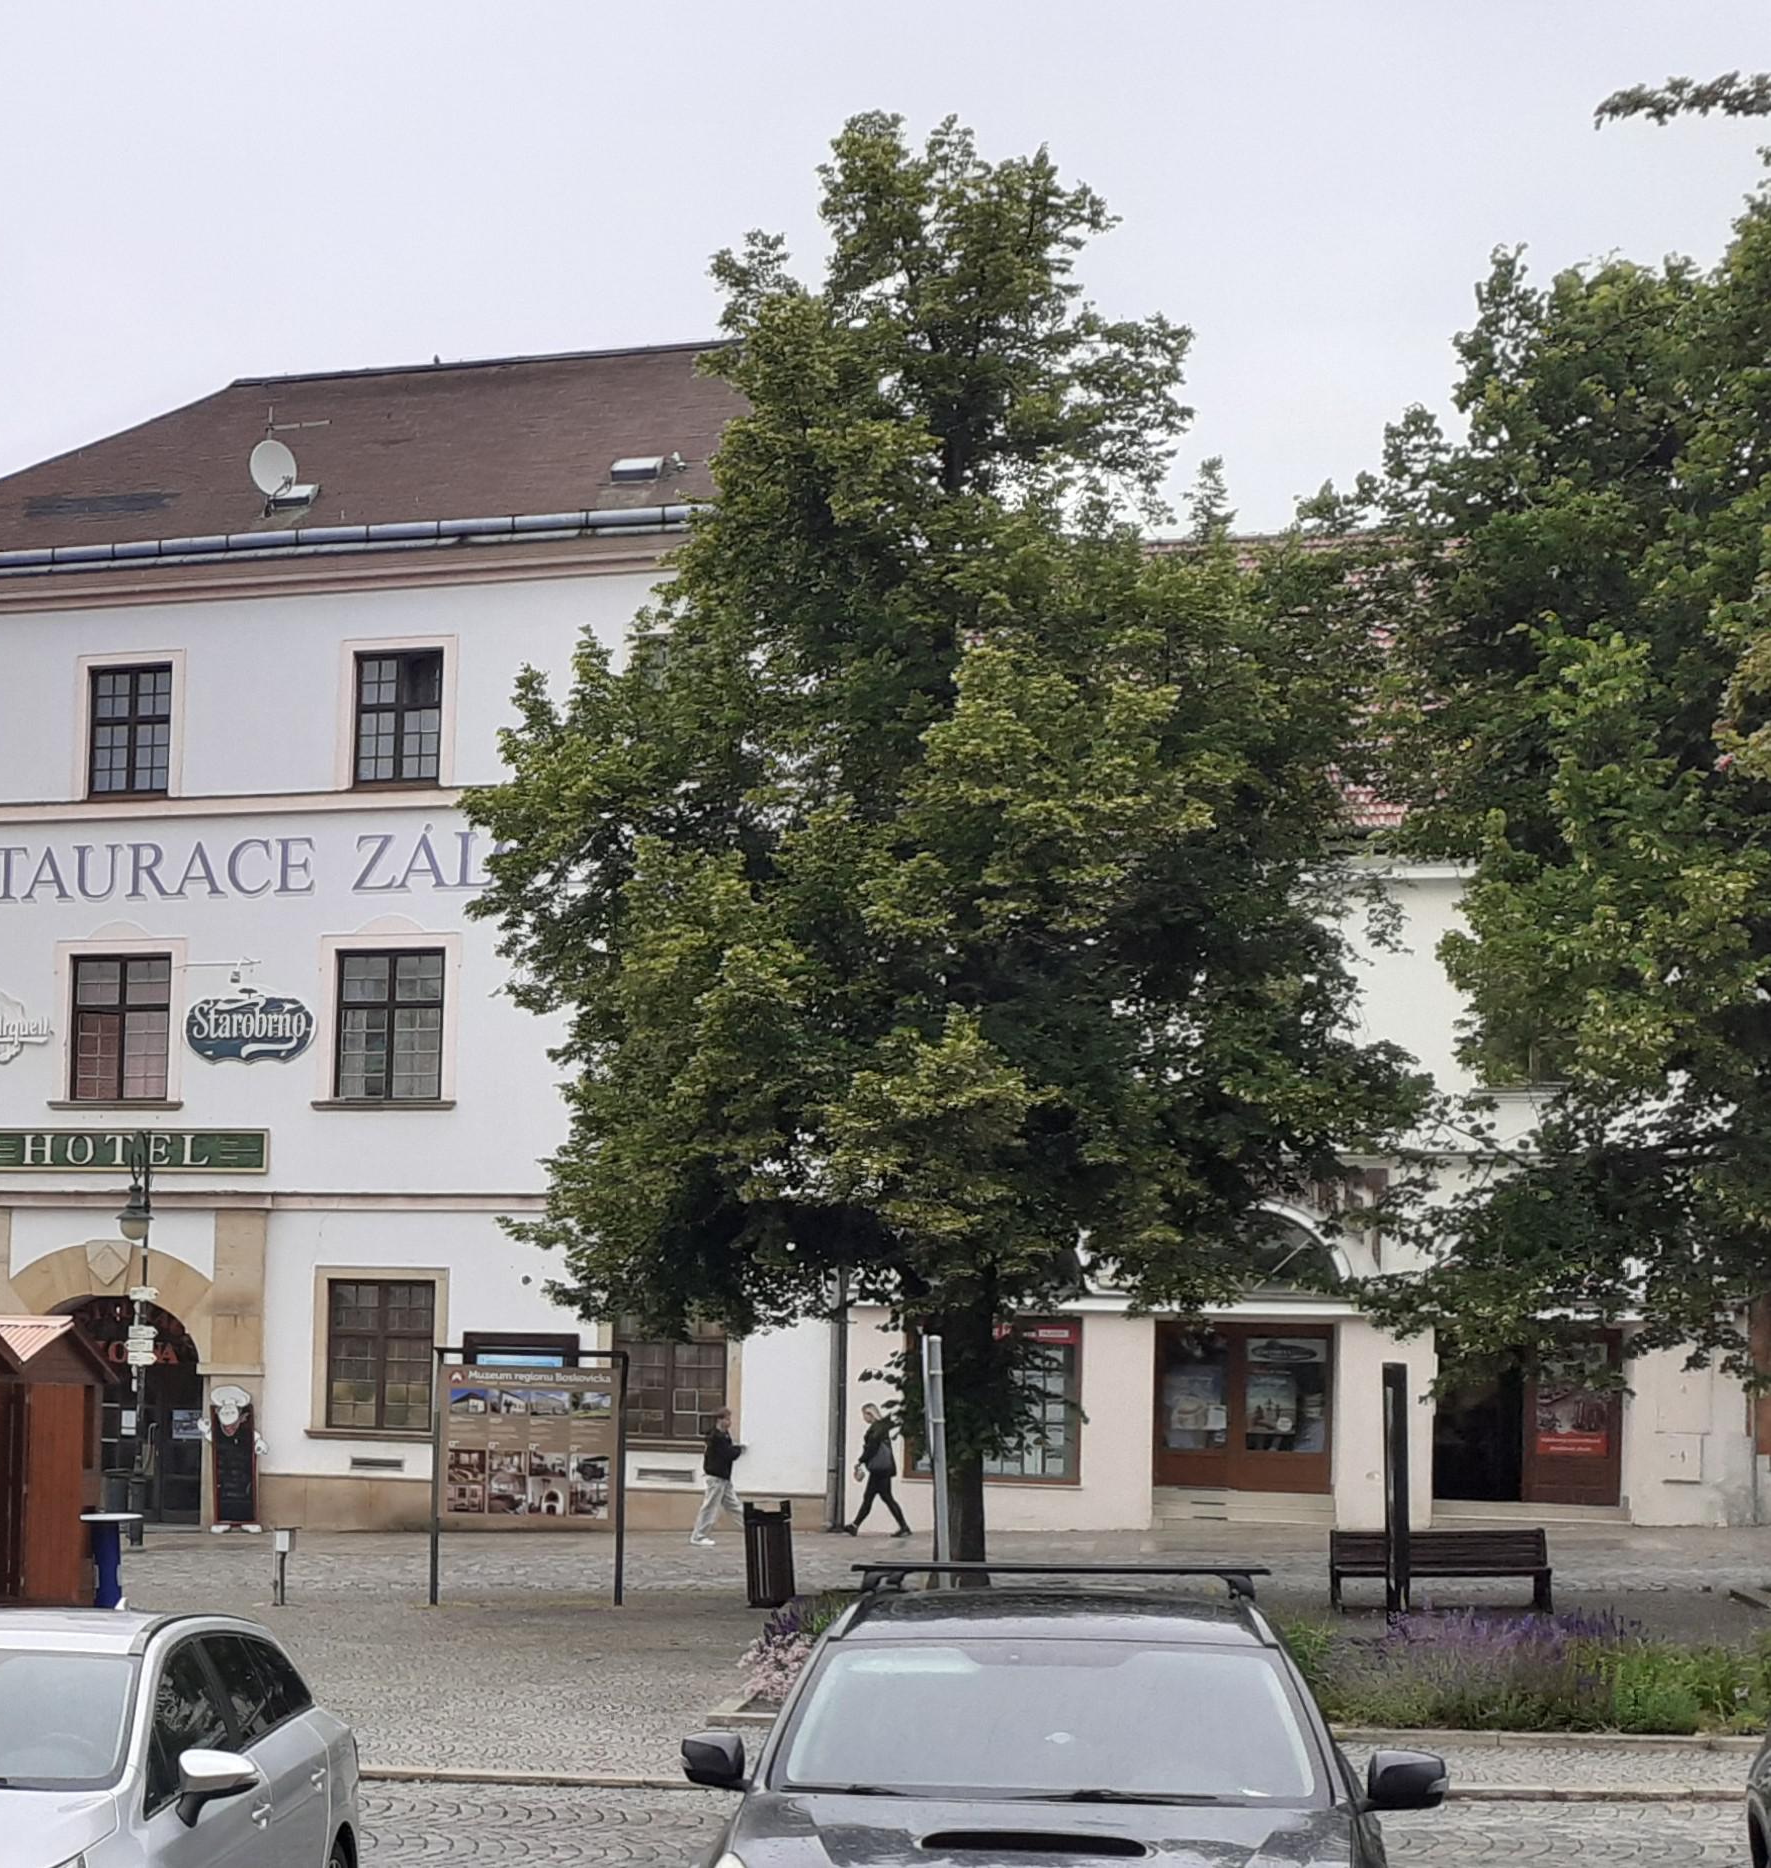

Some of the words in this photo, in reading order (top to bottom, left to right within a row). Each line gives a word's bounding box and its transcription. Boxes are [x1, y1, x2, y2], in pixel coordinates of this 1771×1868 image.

[191, 1001, 309, 1042] Starobrno
[22, 1134, 210, 1166] HOTEL
[468, 1370, 512, 1380] Muzeum
[514, 1372, 553, 1383] regionu
[555, 1373, 611, 1383] Boskovicka
